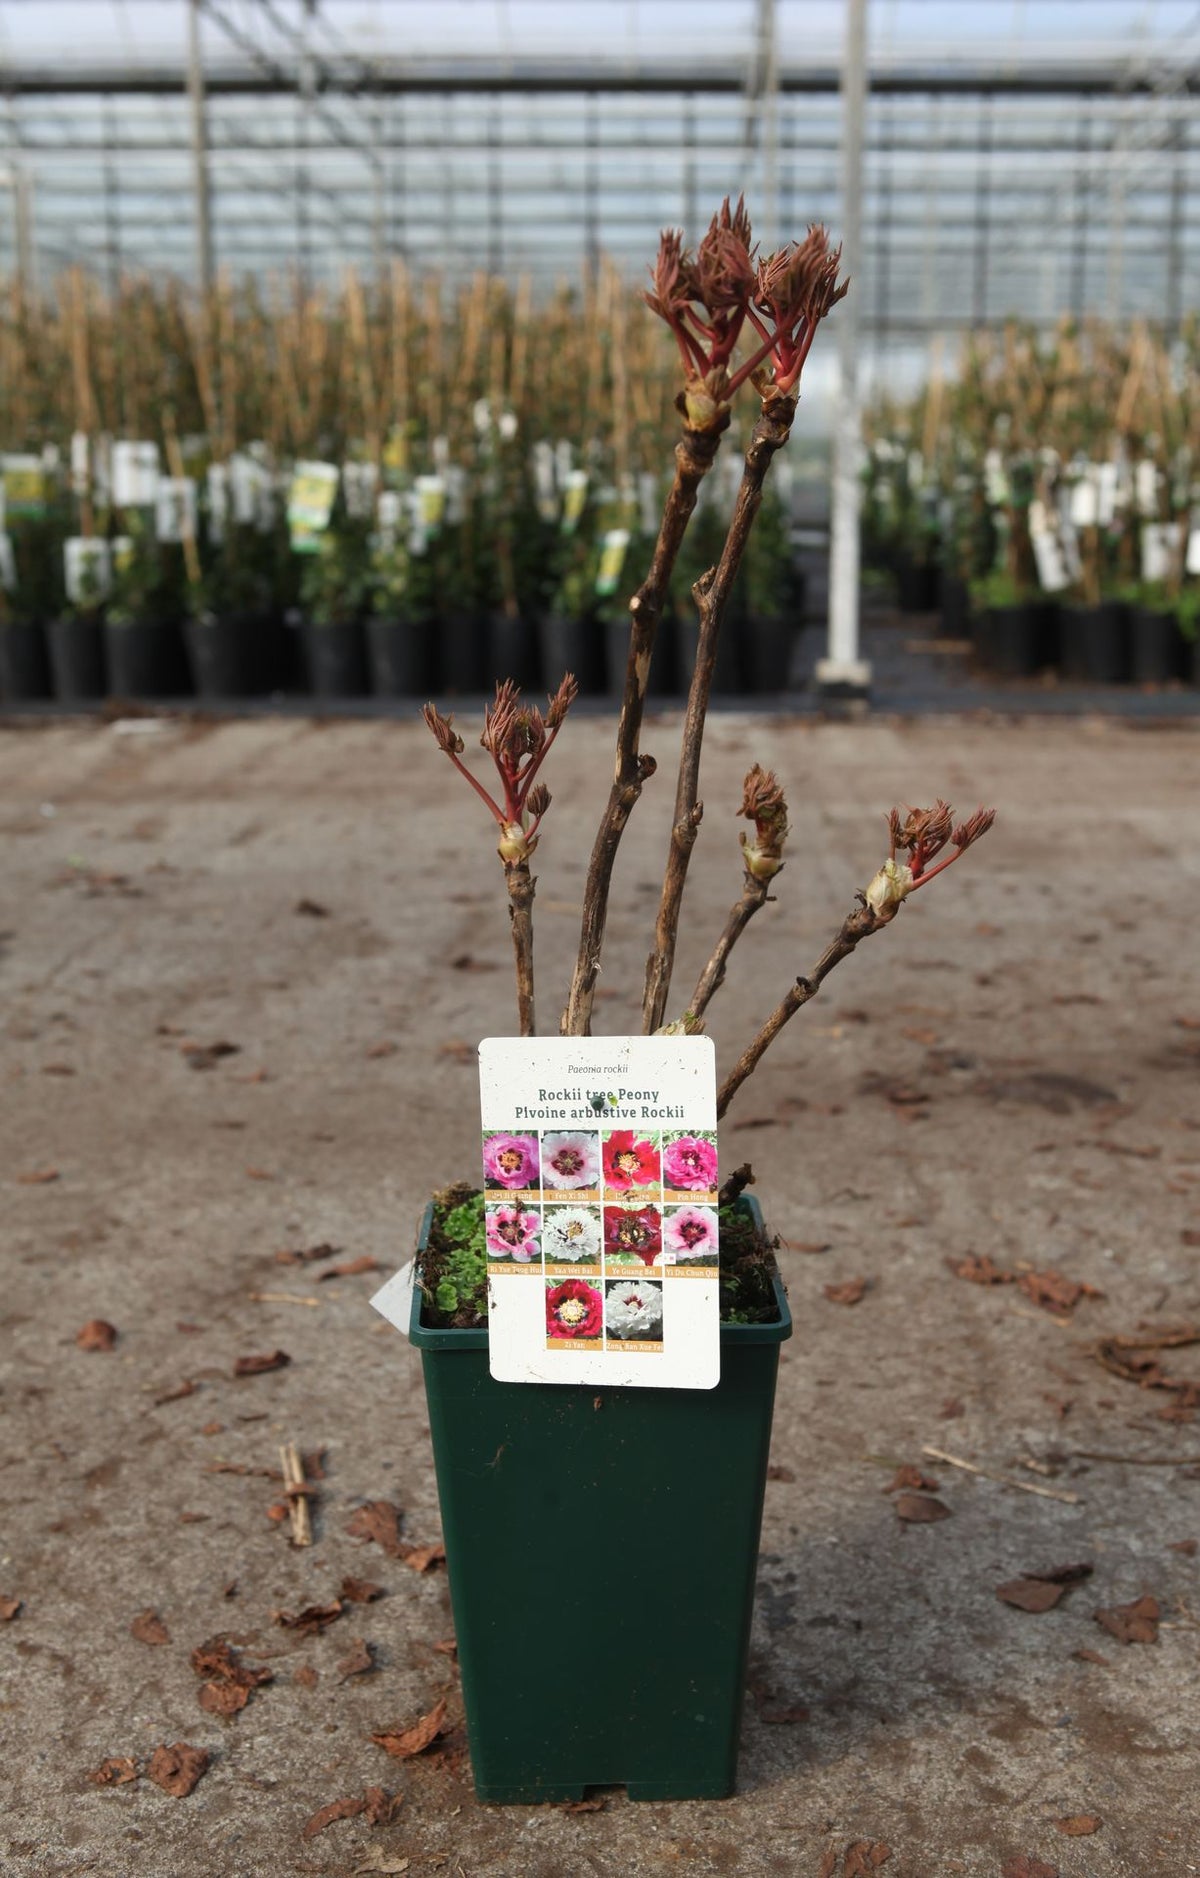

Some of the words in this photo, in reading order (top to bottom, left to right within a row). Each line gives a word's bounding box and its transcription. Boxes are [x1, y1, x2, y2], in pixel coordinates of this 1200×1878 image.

[568, 1064, 602, 1074] Paeonia
[603, 1064, 628, 1074] rockii
[538, 1088, 582, 1102] Rockii
[586, 1089, 614, 1101] tree
[618, 1088, 660, 1103] Peony
[515, 1106, 566, 1119] Pivoine
[570, 1105, 637, 1118] arbustive
[641, 1106, 684, 1118] Rockii
[622, 1268, 643, 1276] Guang
